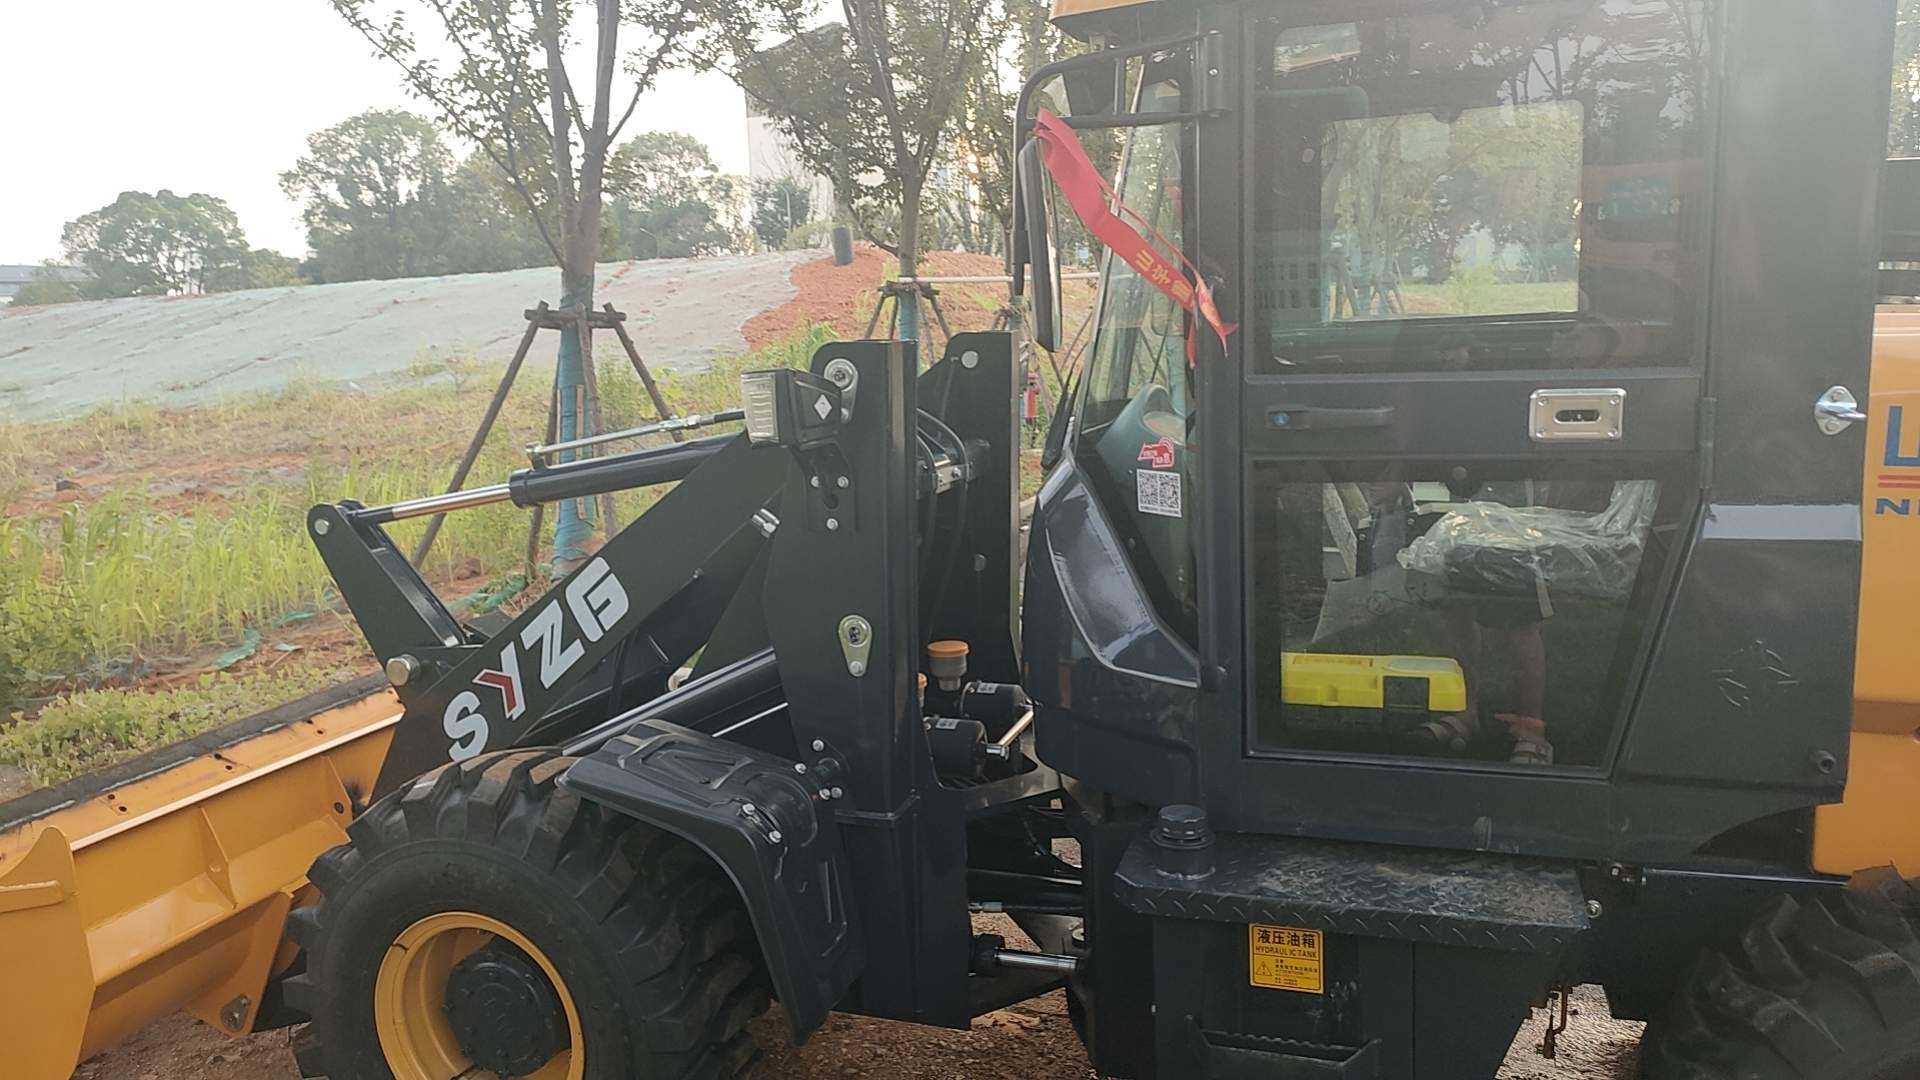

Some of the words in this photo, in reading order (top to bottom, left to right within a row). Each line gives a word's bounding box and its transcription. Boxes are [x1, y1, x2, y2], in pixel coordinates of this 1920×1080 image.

[1884, 406, 1920, 466] L
[1876, 498, 1920, 515] N
[443, 556, 629, 762] SYZG
[1257, 928, 1316, 949] 液压油箱
